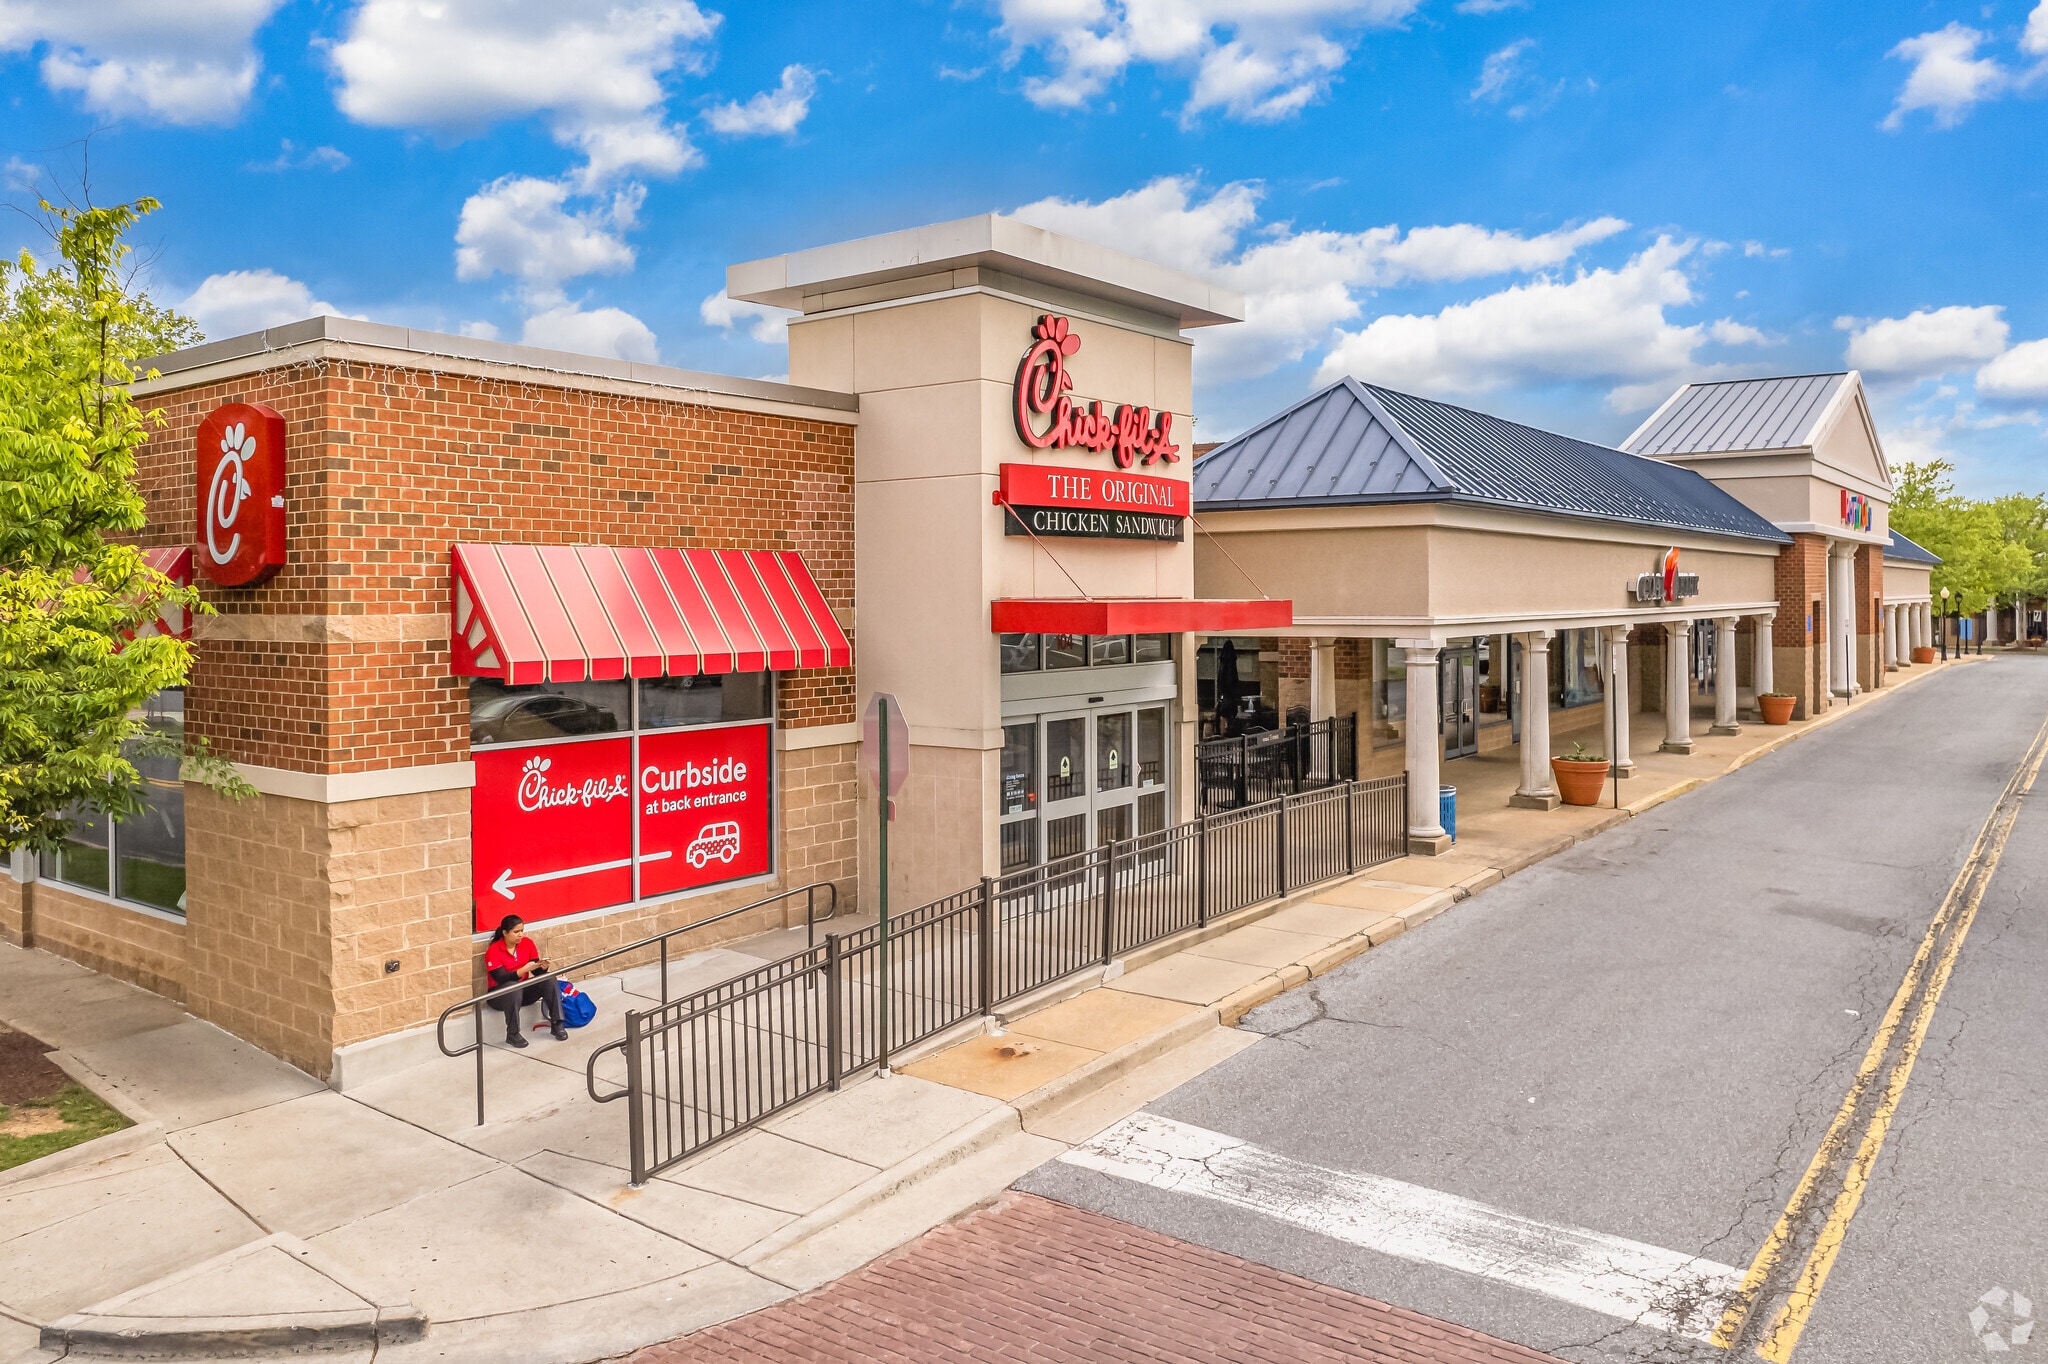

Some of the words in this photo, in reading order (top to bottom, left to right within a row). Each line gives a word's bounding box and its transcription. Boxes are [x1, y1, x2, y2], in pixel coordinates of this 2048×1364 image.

[1012, 338, 1180, 469] Chick-fil-A
[1047, 474, 1092, 500] THE
[1101, 478, 1175, 507] ORIGINAL
[1033, 510, 1109, 533] CHICKEN
[1116, 515, 1175, 537] SANDWICH
[517, 768, 629, 812] Chick-fil-A
[641, 756, 747, 793] Curbside
[645, 800, 659, 815] at
[661, 795, 691, 813] back
[694, 790, 747, 807] entrance
